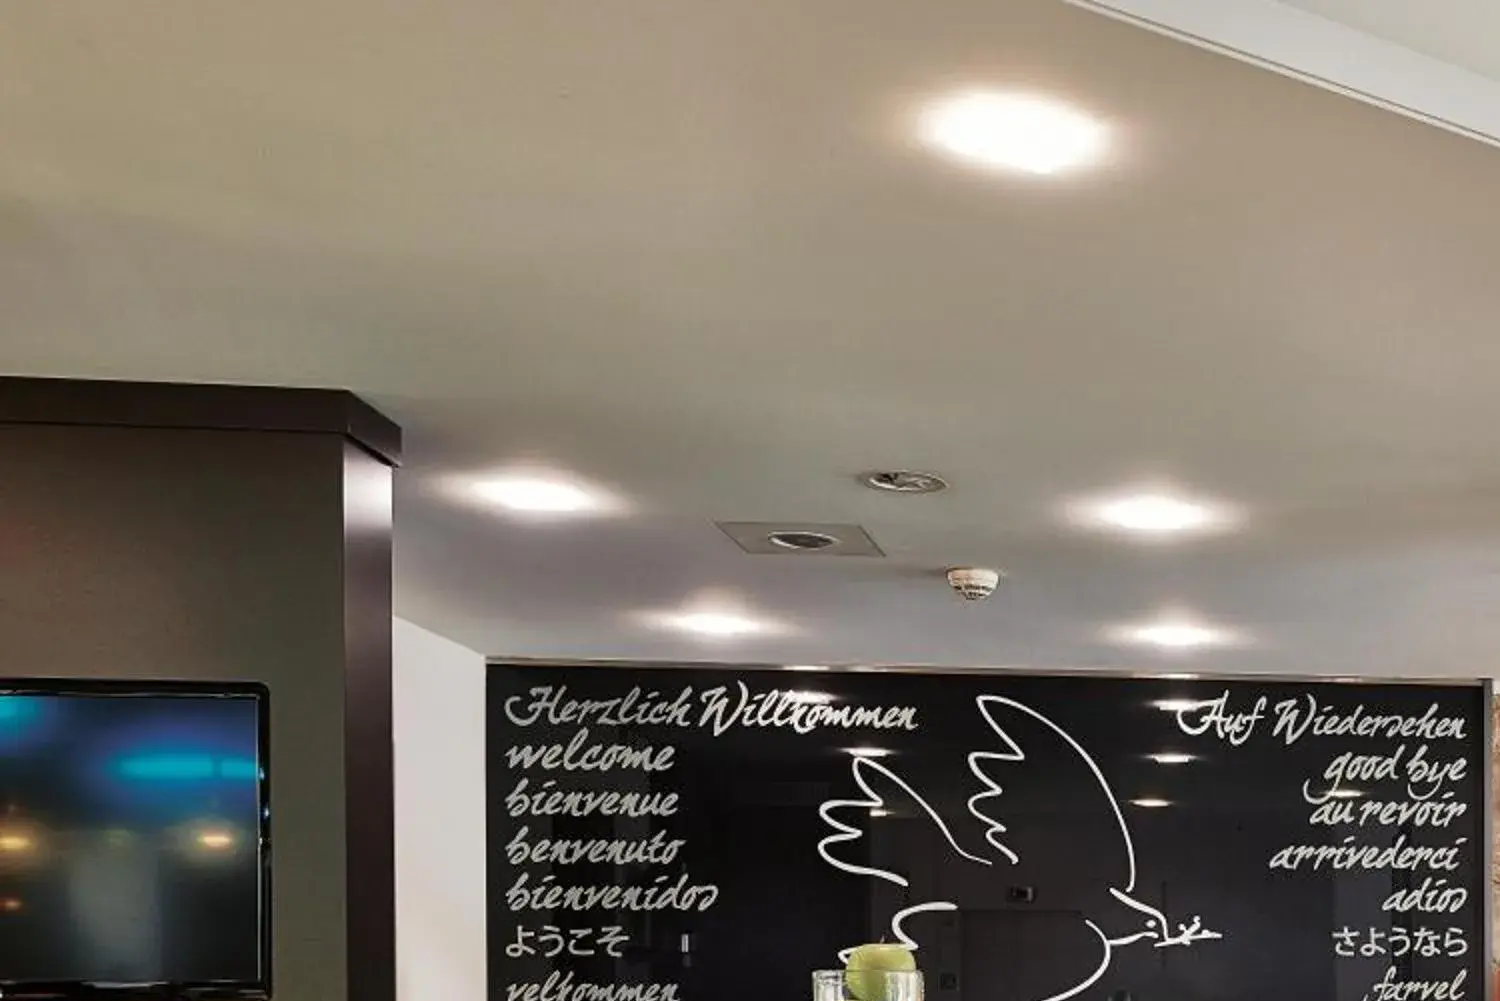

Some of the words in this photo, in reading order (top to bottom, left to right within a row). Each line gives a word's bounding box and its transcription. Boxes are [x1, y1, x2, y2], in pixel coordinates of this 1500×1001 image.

[504, 685, 692, 727] Herzlich
[698, 680, 919, 736] Willkommen
[1177, 690, 1266, 745] Auf
[1273, 693, 1467, 744] Wiedersehen
[505, 728, 675, 771] welcome
[1303, 744, 1404, 804] good
[1405, 745, 1467, 800] bye
[505, 778, 679, 817] bienvenue
[1309, 799, 1354, 825] au
[1359, 791, 1467, 827] revoir
[505, 825, 687, 865] benvenuto
[1269, 834, 1468, 870] arrivederci
[505, 873, 719, 911] bienvenidos
[505, 925, 630, 957] ようこそ
[1332, 926, 1468, 956] さようなら
